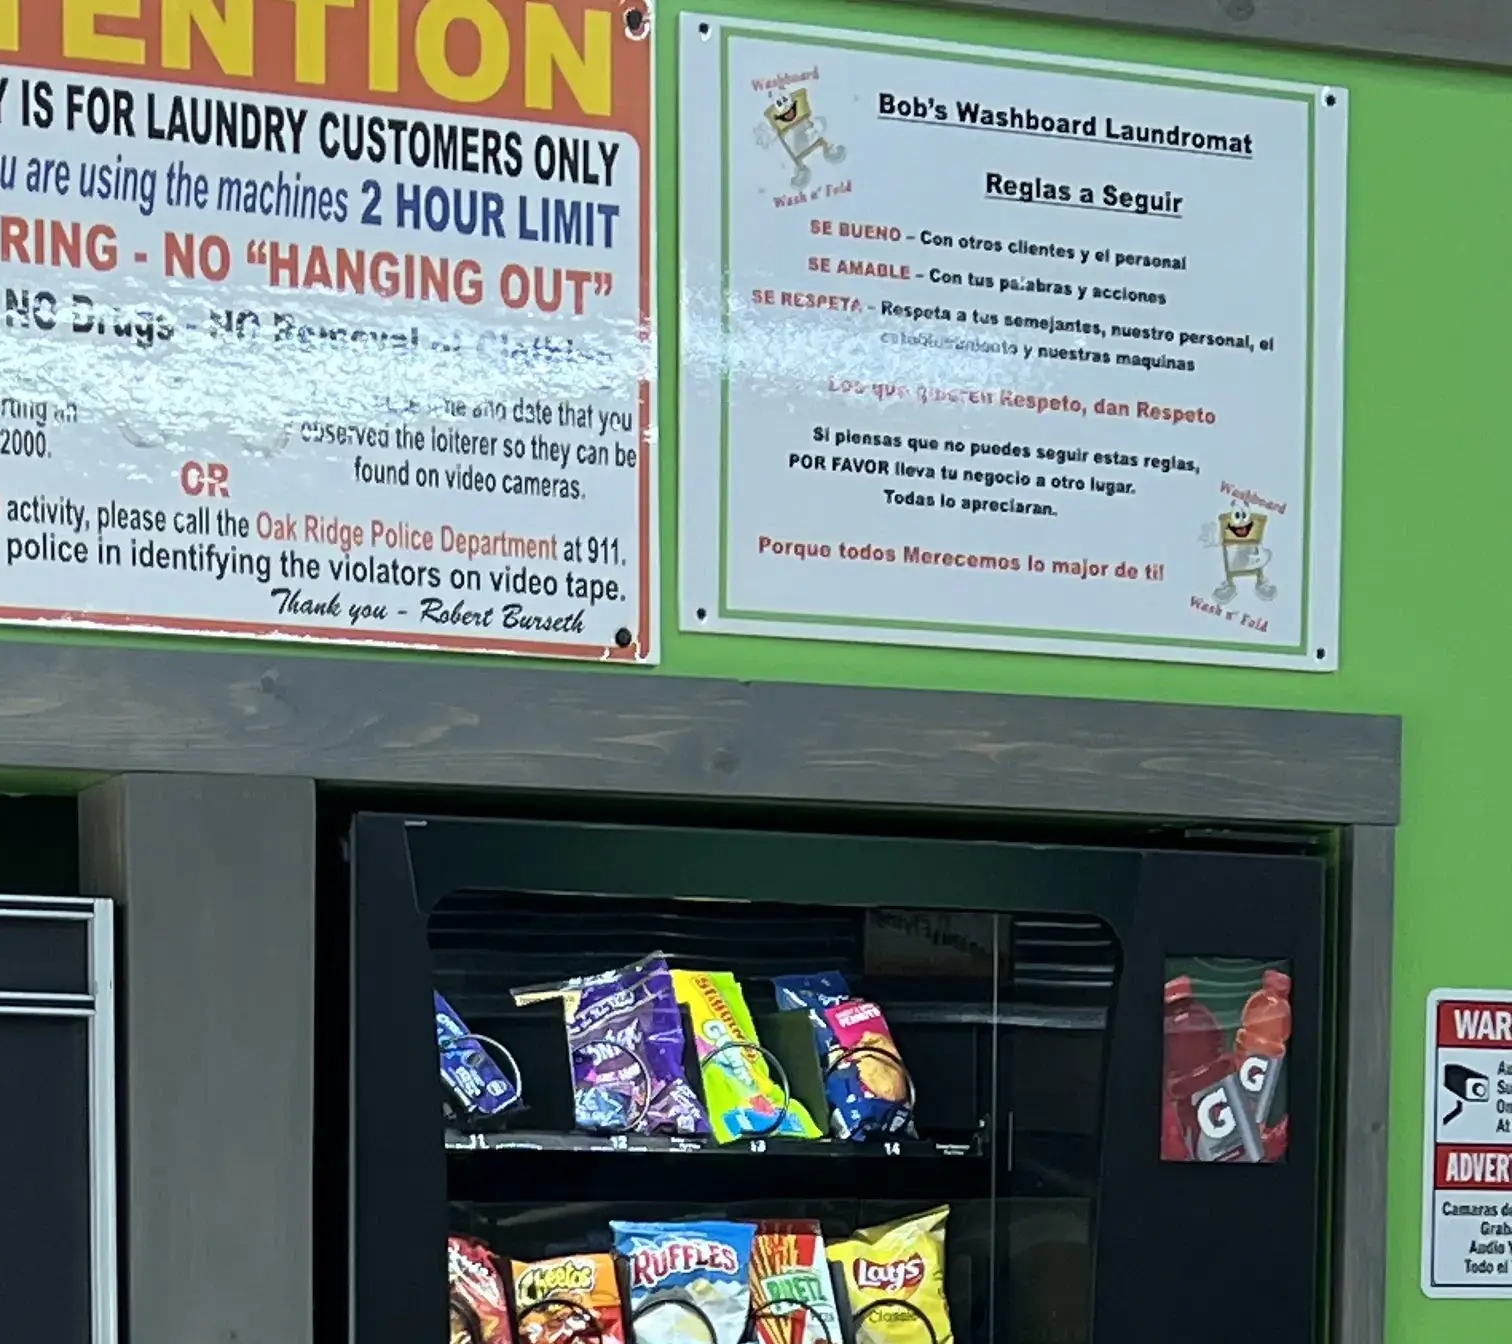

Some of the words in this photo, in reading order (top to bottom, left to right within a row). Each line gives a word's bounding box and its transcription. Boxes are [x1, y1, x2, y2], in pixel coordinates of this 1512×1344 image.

[21, 80, 53, 128] IS
[67, 84, 136, 138] FOR
[148, 93, 307, 155] LAUNDRY
[320, 111, 522, 178] CUSTOMERS
[535, 134, 620, 188] ONLY
[879, 93, 948, 121] Bob's
[956, 101, 1096, 138] Washboard
[1106, 117, 1253, 154] Laundromat
[26, 155, 70, 195] are
[80, 154, 157, 216] using
[166, 148, 208, 209] the
[218, 161, 349, 224] machines
[360, 179, 382, 226] 2
[396, 182, 506, 239] HOUR
[518, 195, 620, 249] LIMIT
[986, 172, 1071, 202] Reglas
[1079, 186, 1093, 203] a
[1103, 185, 1183, 214] Seguir
[164, 231, 231, 282] NO
[1008, 240, 1075, 259] clientes
[1095, 248, 1110, 262] el
[1115, 252, 1187, 270] personal
[1038, 345, 1111, 364] nuestras
[1116, 352, 1195, 372] maquinas
[354, 456, 409, 486] found
[415, 464, 439, 487] on
[445, 463, 496, 492] video
[502, 472, 586, 500] cameras.
[789, 453, 826, 471] POR
[832, 456, 889, 475] FAVOR
[895, 463, 935, 478] lleva
[371, 520, 434, 551] Police
[441, 525, 558, 561] Department
[563, 538, 582, 562] at
[587, 537, 627, 566] 911.
[758, 536, 831, 560] Porque
[839, 542, 896, 562] todos
[420, 597, 493, 627] Robert
[502, 603, 585, 634] Burseth
[517, 1261, 595, 1305] Cheetos
[632, 1241, 737, 1286] RUFFLES
